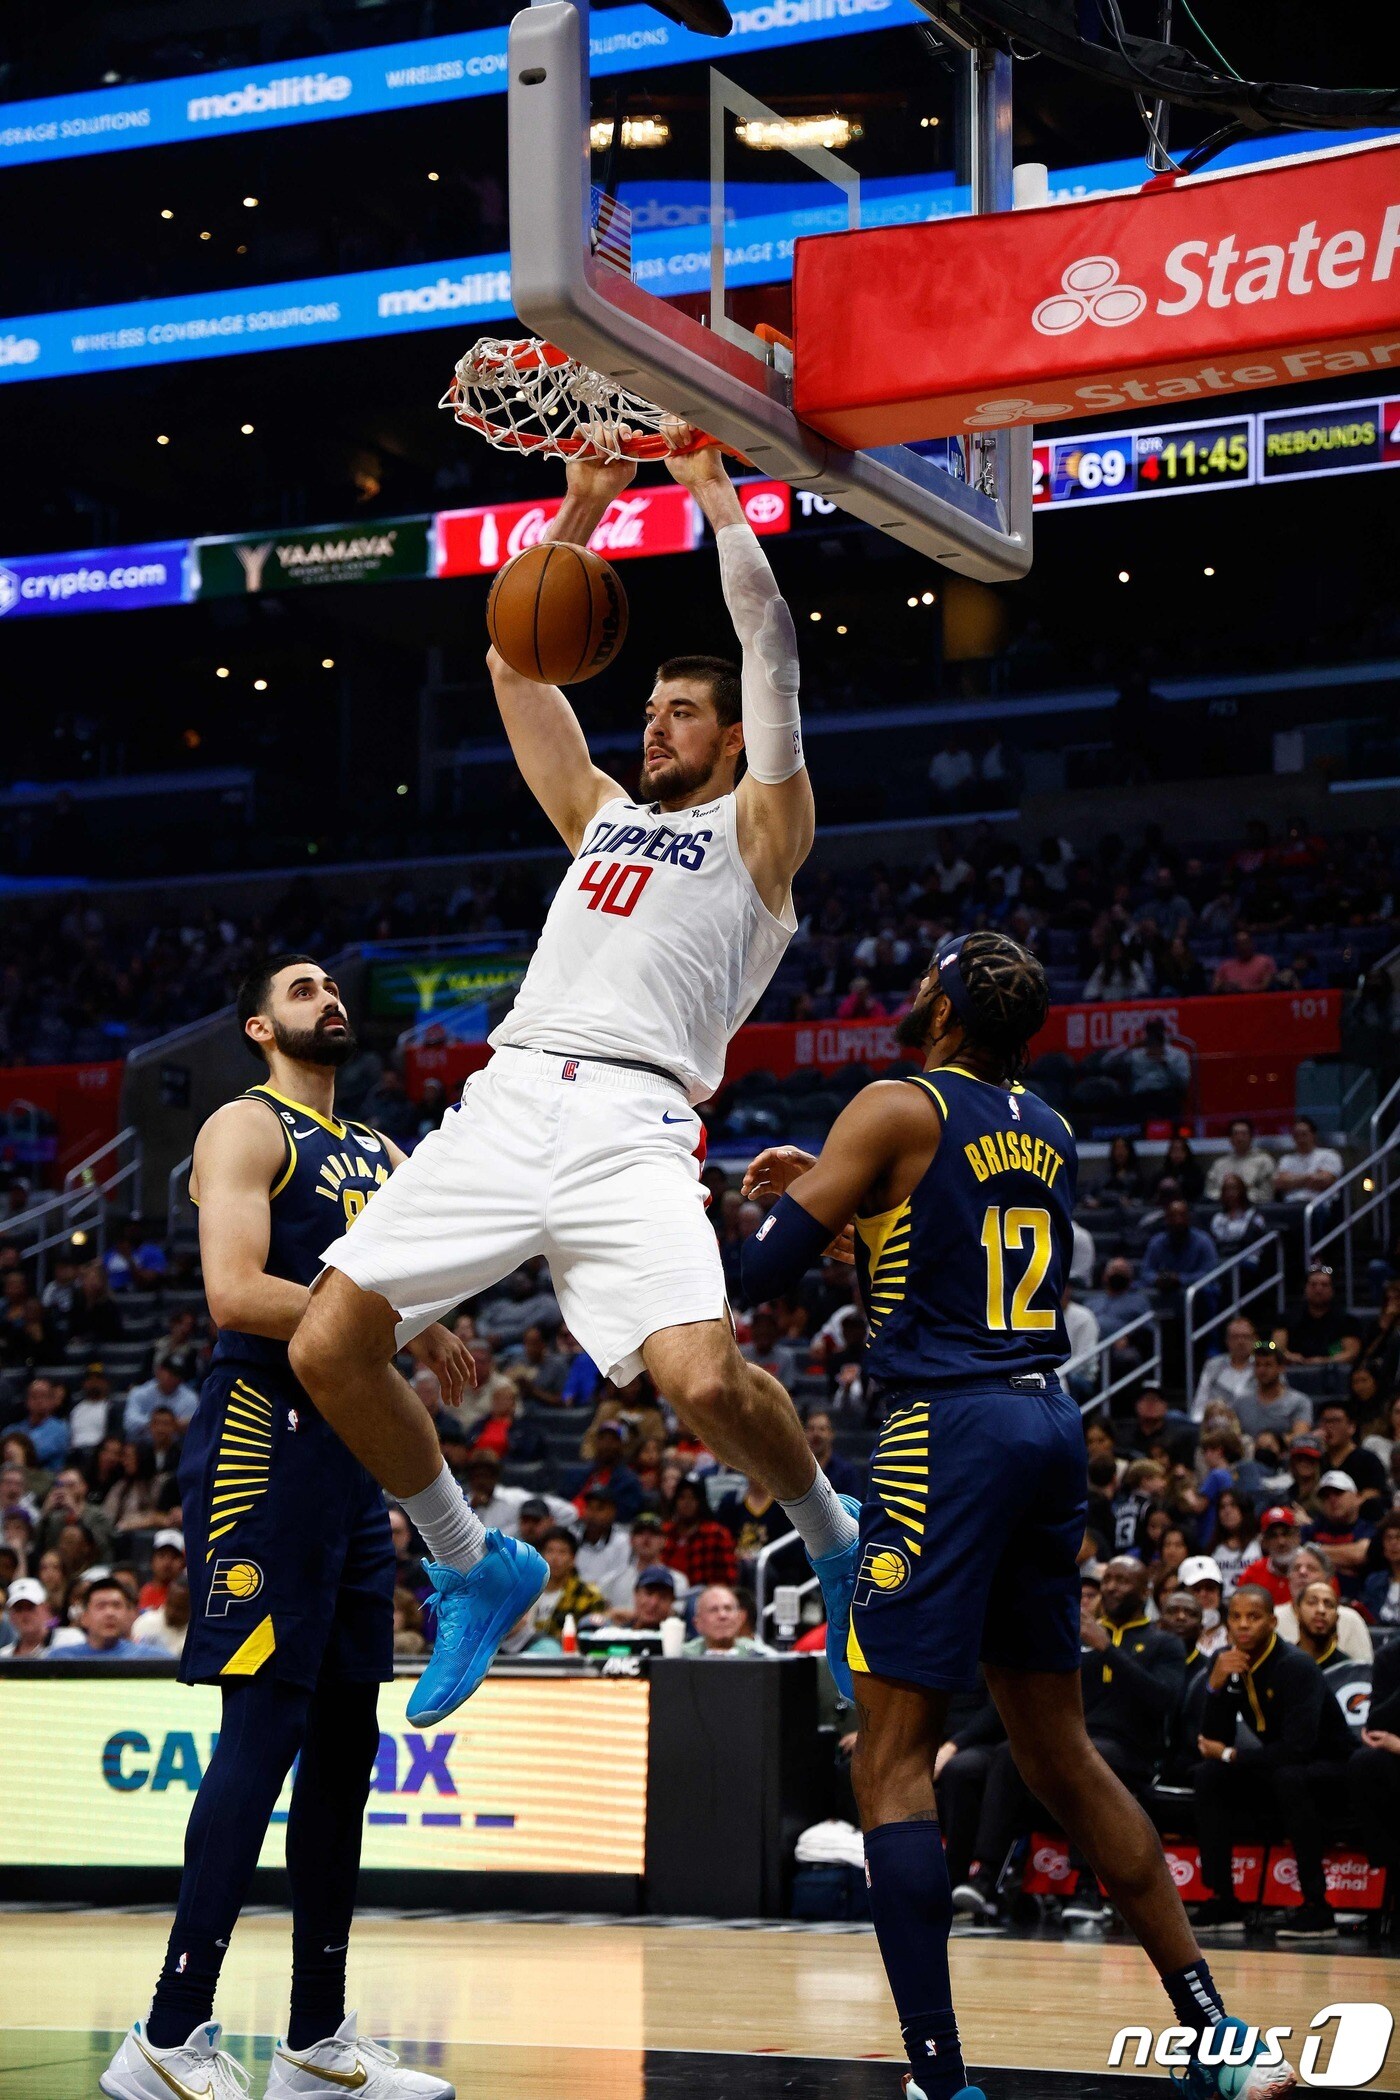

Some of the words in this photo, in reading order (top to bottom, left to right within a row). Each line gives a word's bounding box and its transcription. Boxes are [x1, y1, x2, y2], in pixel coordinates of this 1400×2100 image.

[187, 73, 352, 122] mobilitie
[386, 60, 463, 88] WIRELESS
[60, 108, 150, 138] SOLUTIONS
[1157, 220, 1365, 316] State
[71, 327, 147, 353] WIRELESS
[148, 314, 244, 345] COVERAGE
[246, 302, 341, 332] SOLUTIONS
[1075, 363, 1277, 409] State
[1141, 455, 1160, 481] 4
[1161, 434, 1248, 479] 11:45
[1266, 421, 1376, 457] REBOUNDS
[1078, 449, 1126, 490] 69
[21, 564, 167, 600] crypto.com
[579, 822, 713, 871] CLIPPERS
[578, 861, 654, 917] 40
[964, 1130, 1064, 1189] BRISSETT
[980, 1205, 1056, 1331] 12
